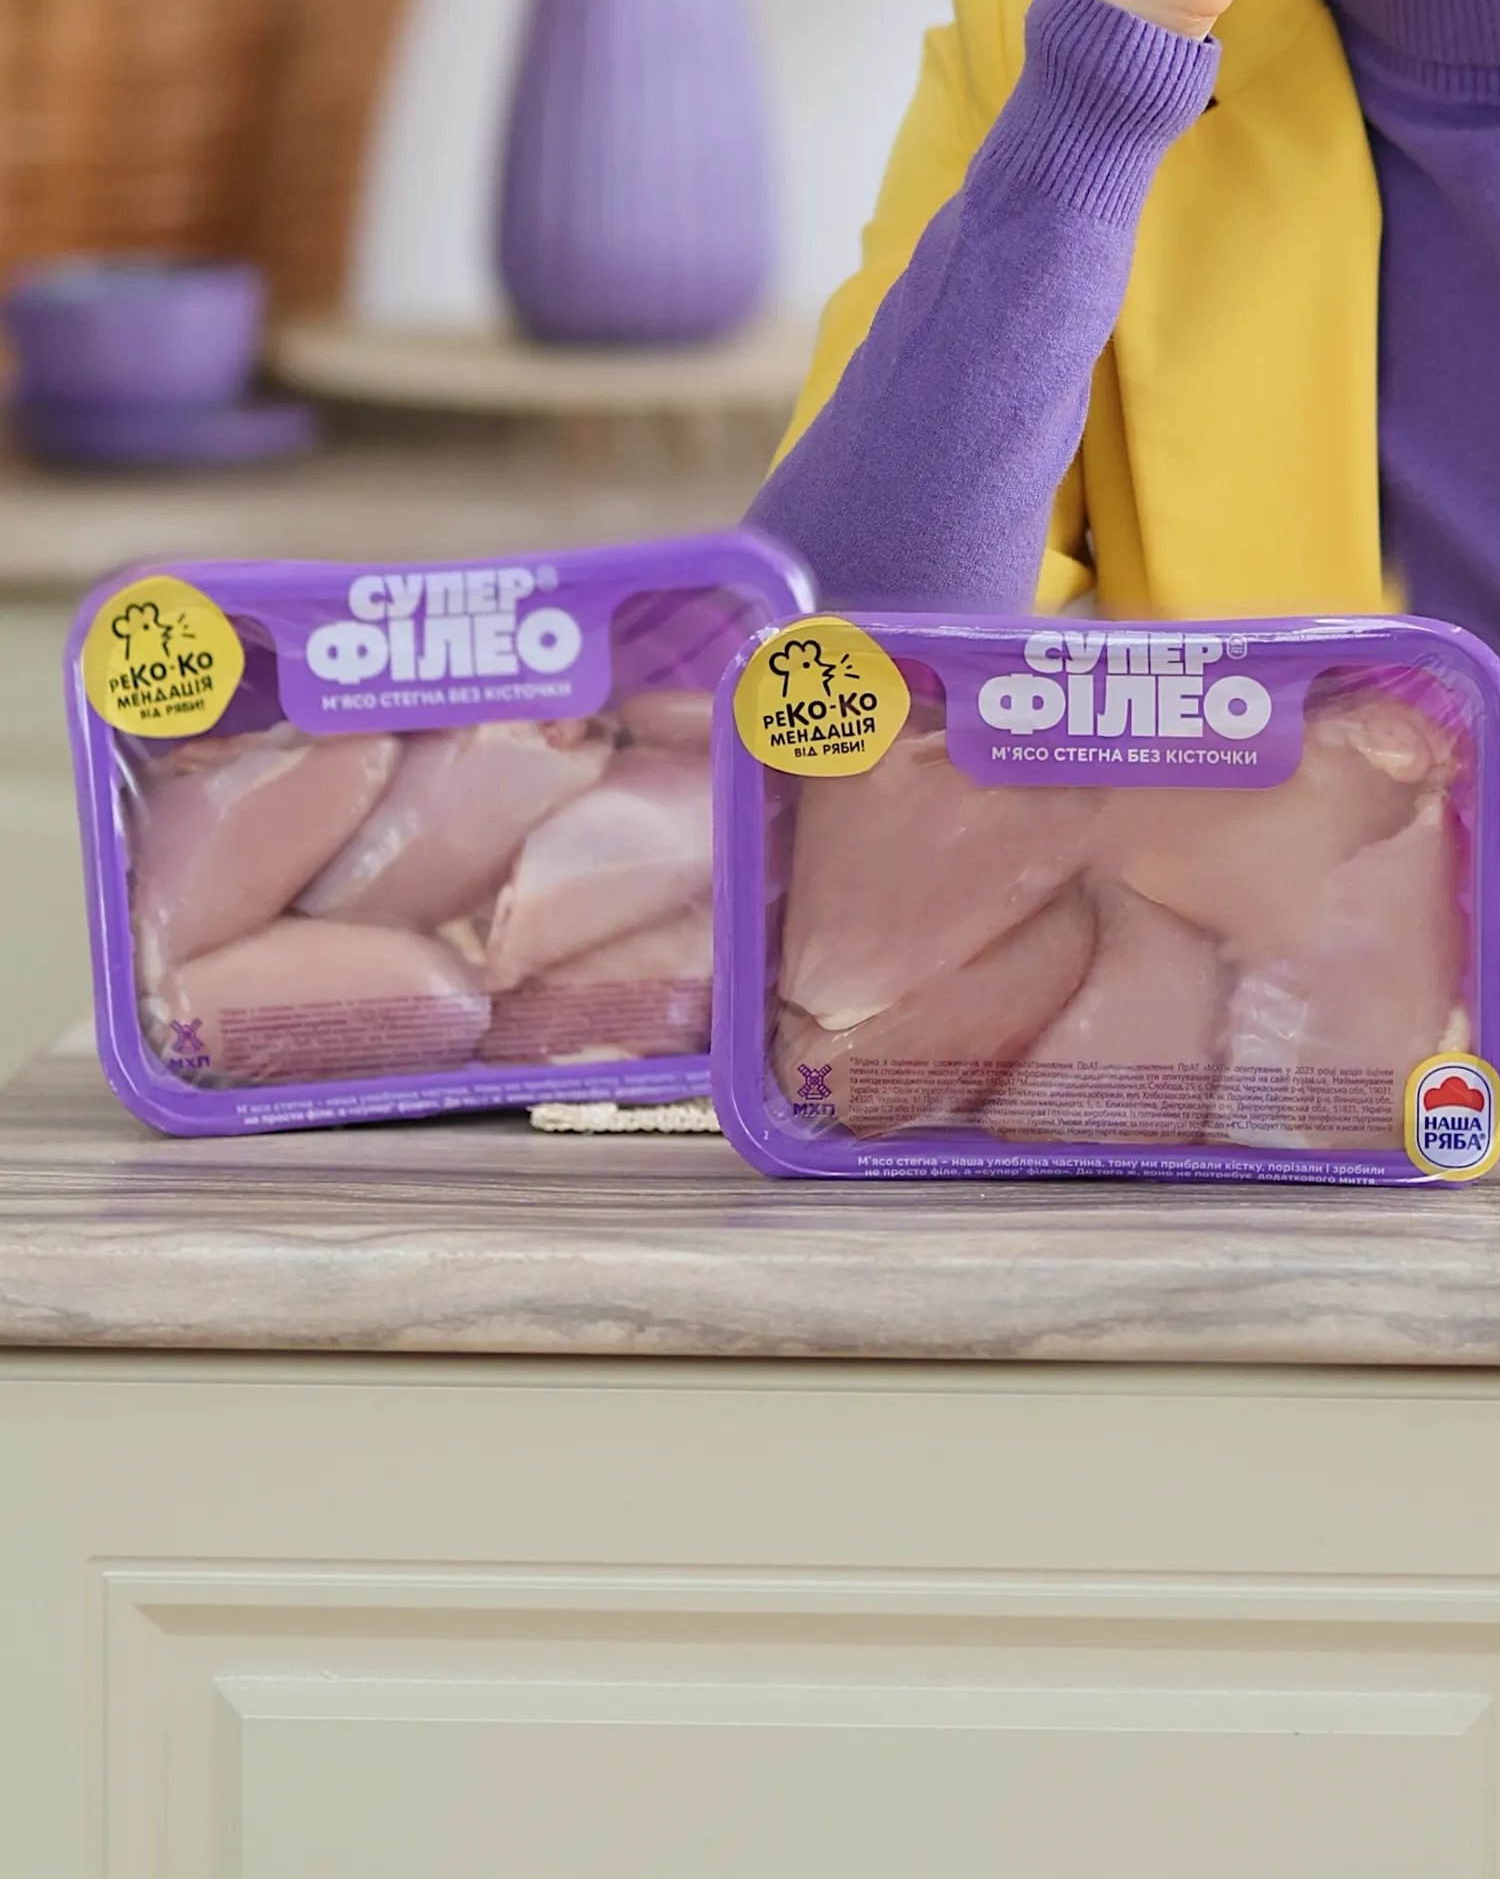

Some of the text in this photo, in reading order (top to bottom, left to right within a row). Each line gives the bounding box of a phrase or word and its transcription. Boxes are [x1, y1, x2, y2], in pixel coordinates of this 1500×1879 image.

[348, 567, 535, 621] СУПЕР
[306, 607, 582, 685] ФІЛЕО
[1024, 633, 1222, 675] СУПЕР
[117, 676, 213, 710] МЕНДАЦІЯ
[380, 691, 444, 708] СТЕГНА
[448, 688, 481, 704] БЕЗ
[485, 683, 572, 701] КІСТОЧКИ
[978, 674, 1272, 740] ФІЛЕО
[770, 717, 875, 747] МЕНДАЦІЯ
[794, 739, 865, 758] ВІД РЯБИ!
[991, 747, 1258, 765] М'ЯСО СТЕГНА БЕЗ КІСТОЧКИ
[793, 1103, 836, 1117] МХП
[1424, 1116, 1482, 1131] НАША
[857, 1155, 894, 1167] М'ясо
[896, 1158, 938, 1167] стегна
[951, 1157, 984, 1167] наша
[987, 1156, 1049, 1168] улюблена
[1108, 1159, 1138, 1169] тому
[1141, 1160, 1158, 1168] ми
[1160, 1158, 1222, 1171] прибрали
[1268, 1162, 1323, 1174] порізали
[1332, 1163, 1386, 1176] зробили
[883, 1168, 927, 1178] просто
[1257, 1171, 1336, 1184] додаткового
